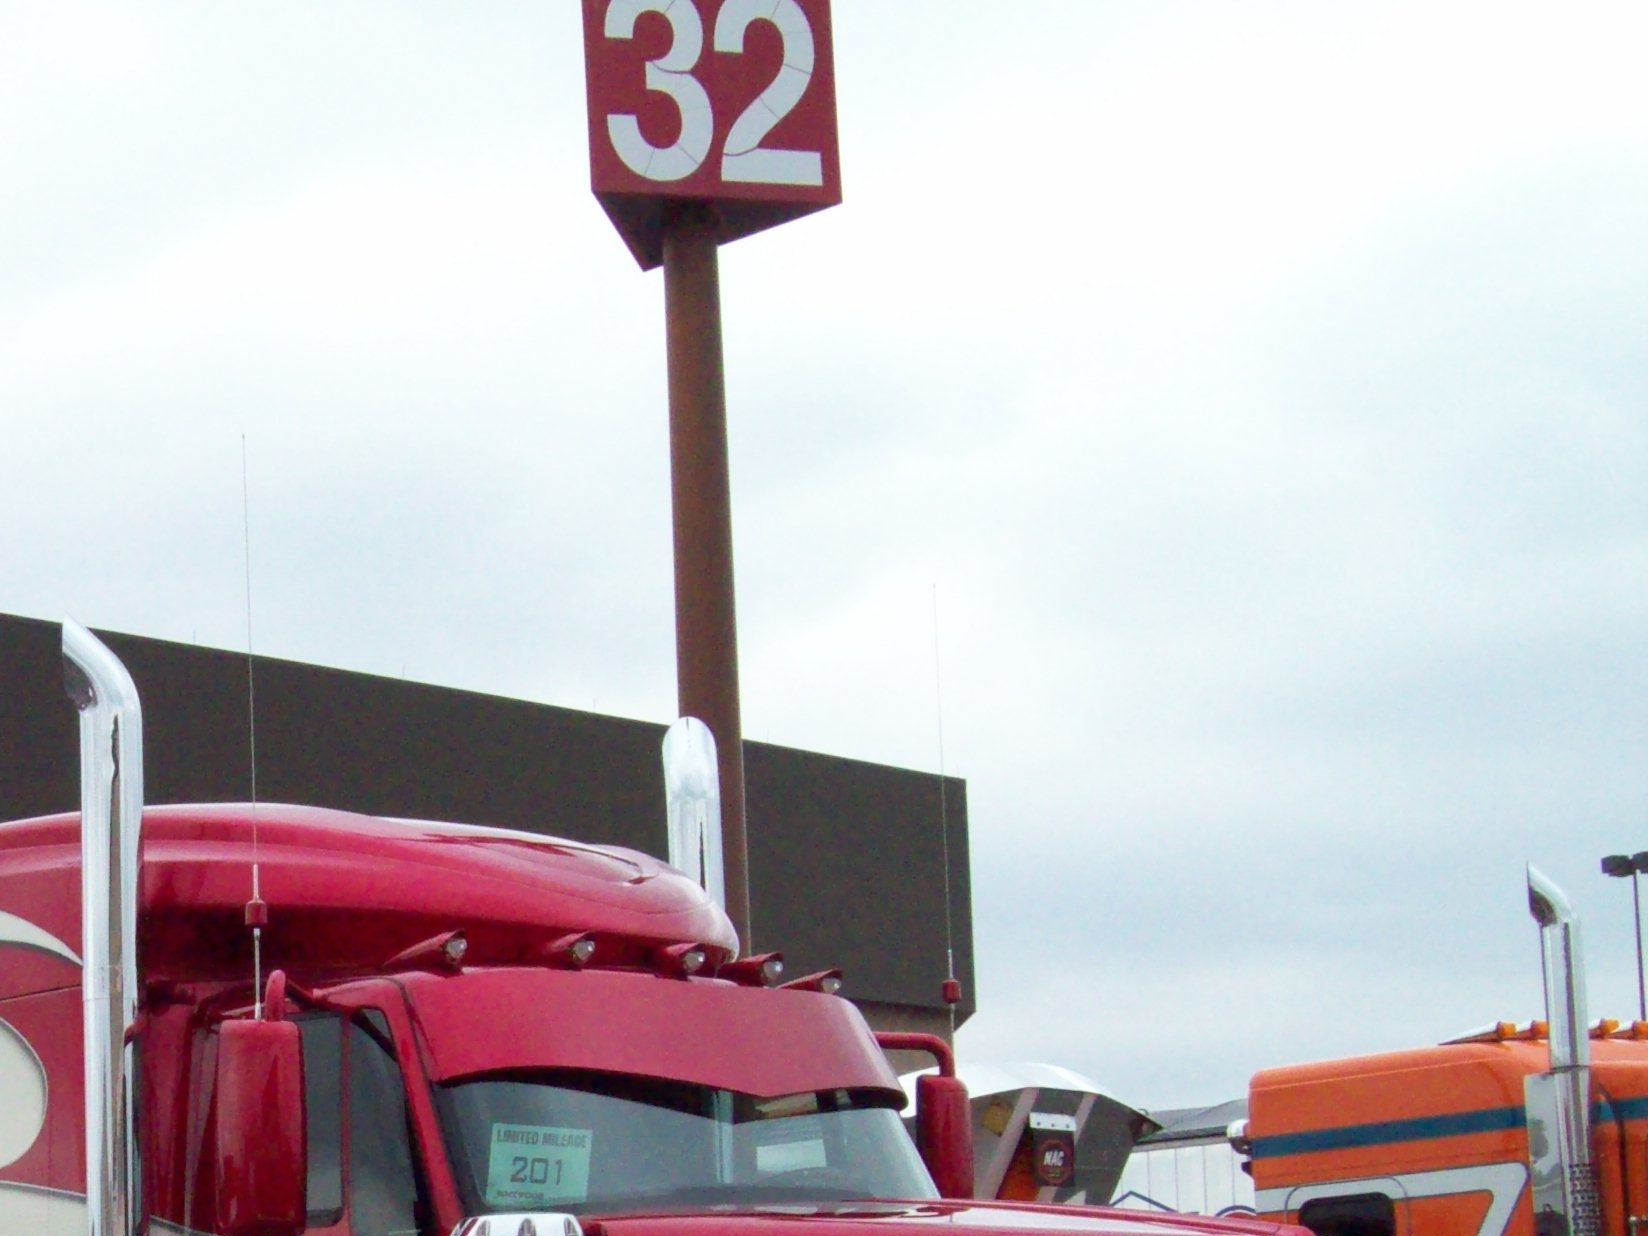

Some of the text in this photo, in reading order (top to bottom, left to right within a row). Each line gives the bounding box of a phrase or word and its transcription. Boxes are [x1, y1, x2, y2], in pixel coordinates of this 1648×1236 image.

[604, 0, 823, 186] 32
[497, 1128, 587, 1148] LIMITED MILEAGE
[511, 1156, 564, 1185] 201
